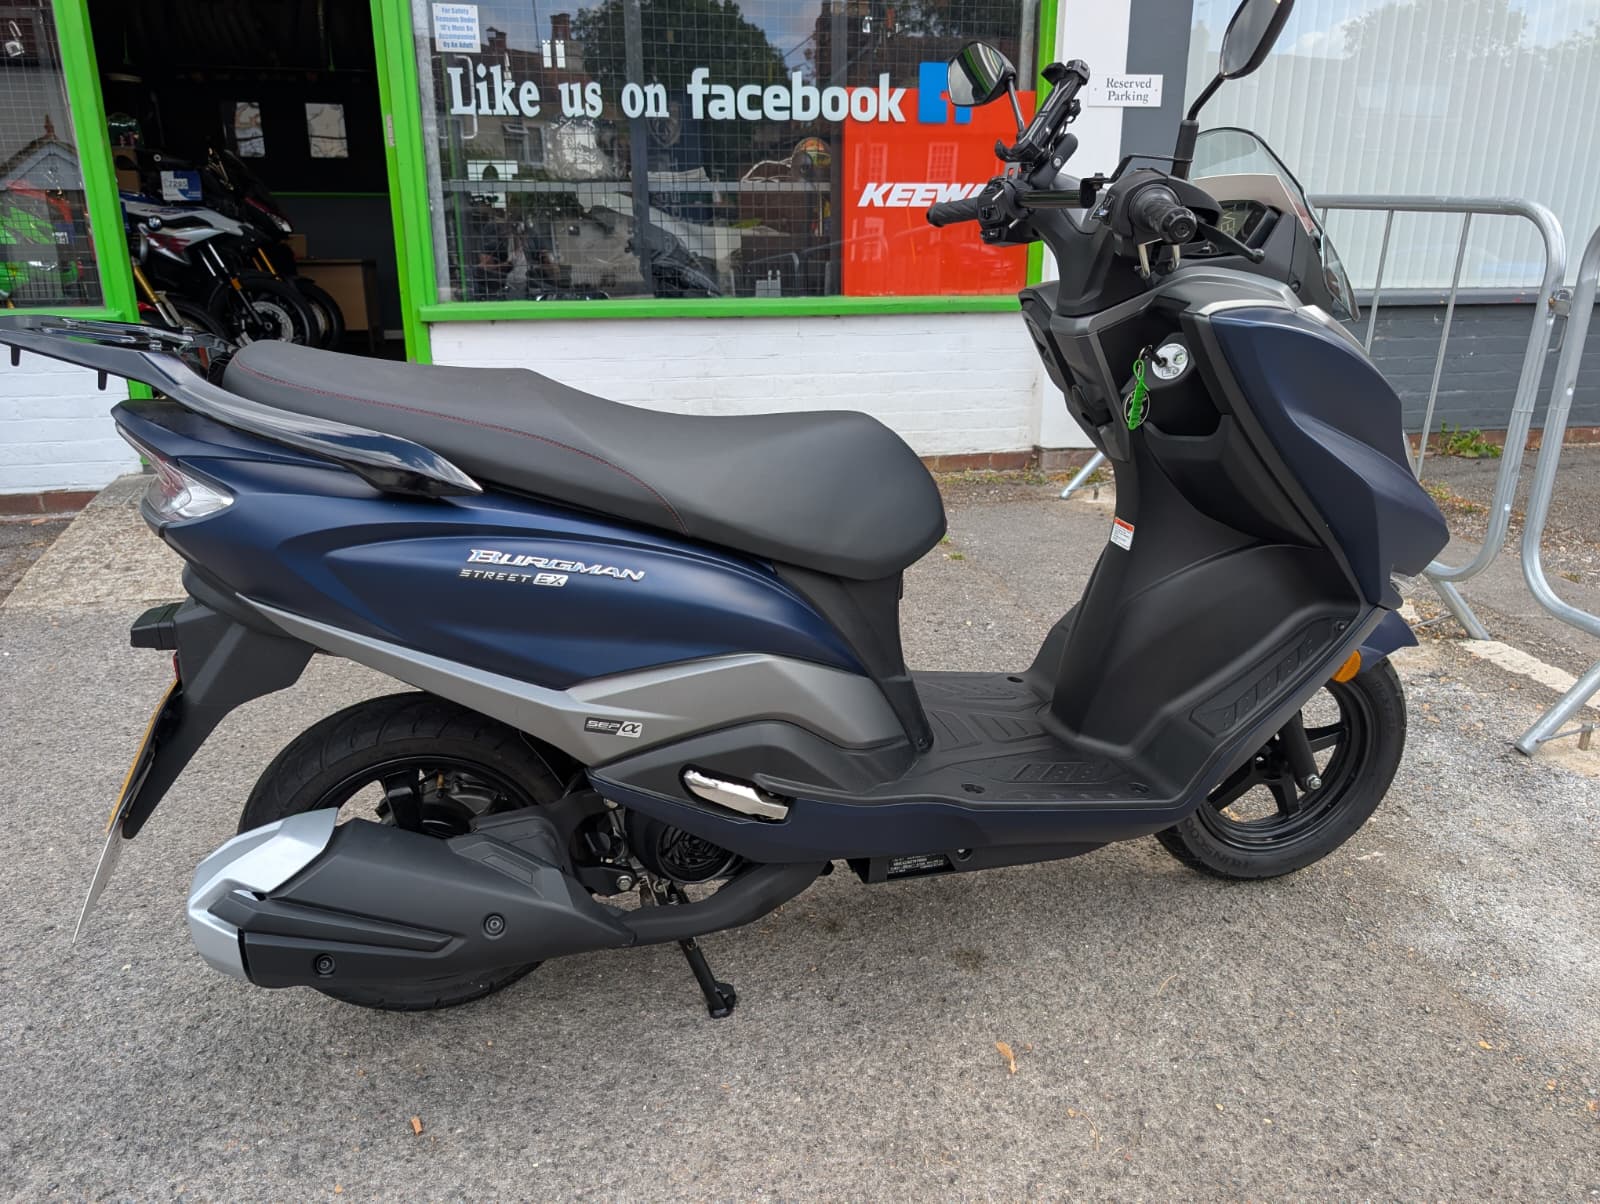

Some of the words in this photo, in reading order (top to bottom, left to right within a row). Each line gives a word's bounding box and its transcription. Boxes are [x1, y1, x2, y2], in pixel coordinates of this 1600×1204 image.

[1106, 77, 1152, 89] Reserved
[447, 63, 540, 117] Like
[558, 81, 603, 118] us
[621, 82, 669, 118] on
[687, 67, 906, 122] facebook
[1108, 90, 1149, 104] Parking
[467, 549, 645, 581] BURGMAN
[459, 569, 532, 583] STREET
[535, 573, 567, 587] EX
[586, 720, 620, 731] SEP
